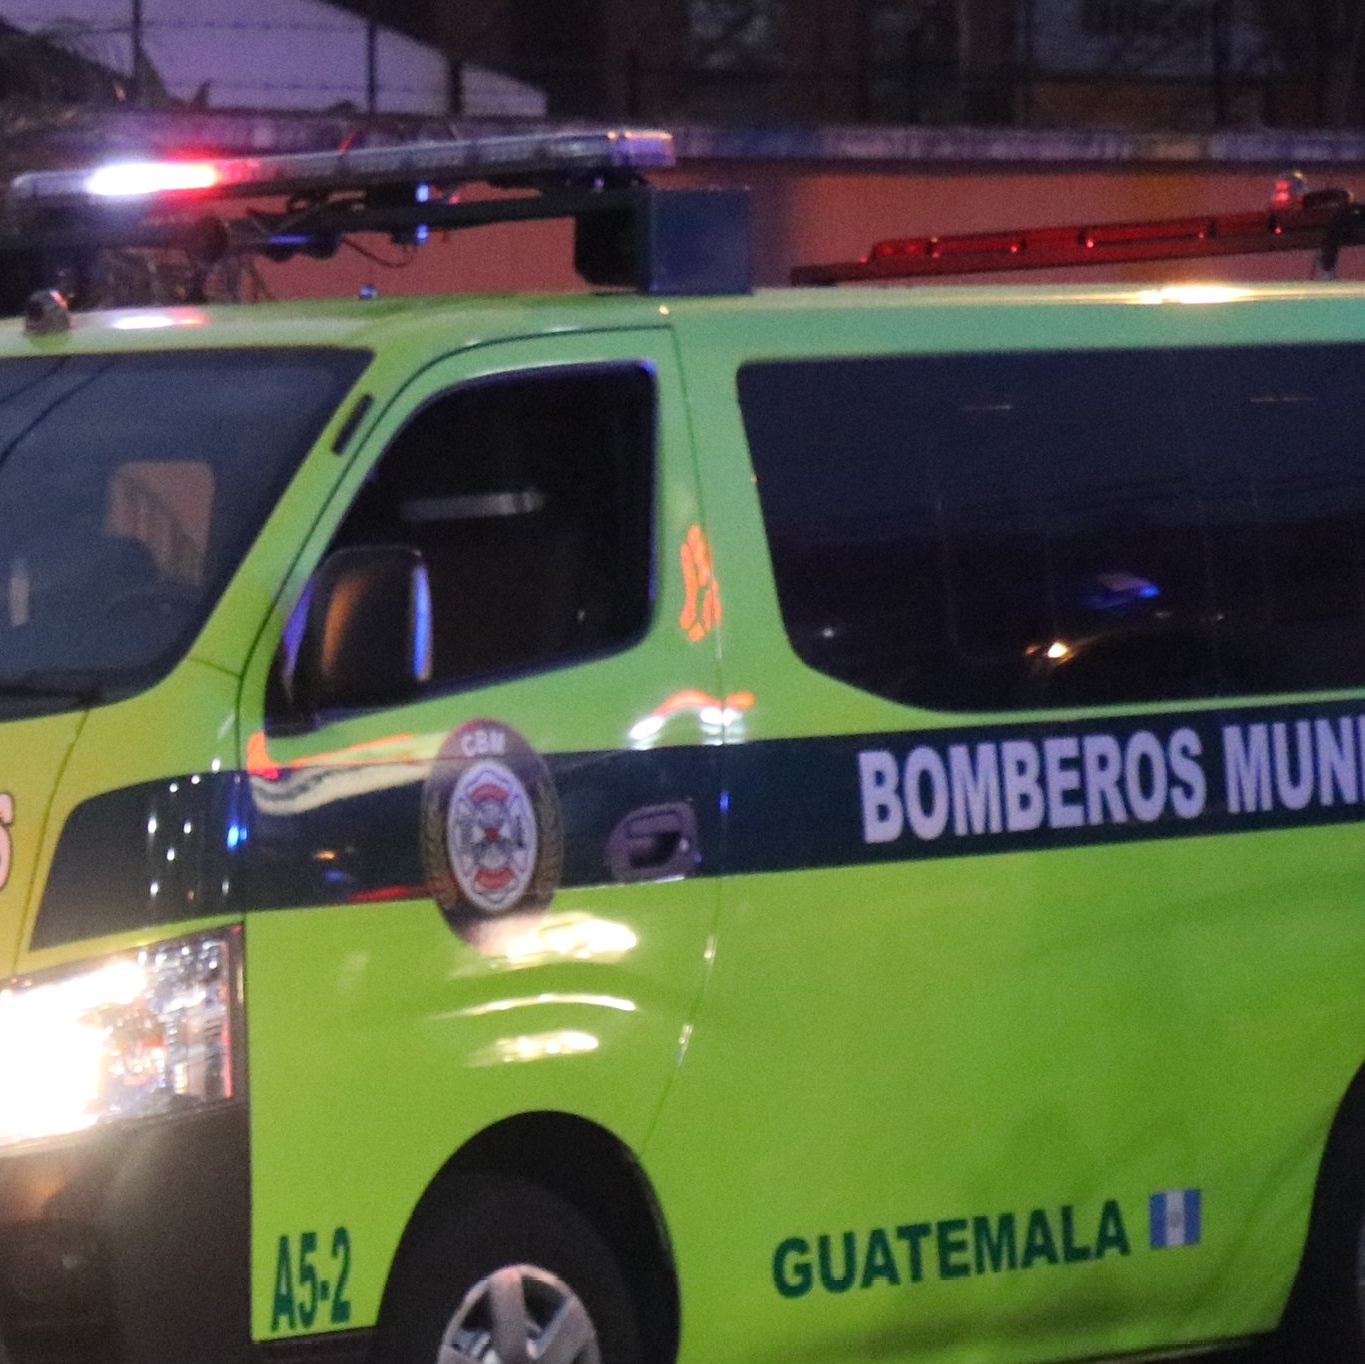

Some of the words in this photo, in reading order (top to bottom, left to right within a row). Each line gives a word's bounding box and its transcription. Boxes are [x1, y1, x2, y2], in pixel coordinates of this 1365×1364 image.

[858, 727, 1207, 844] BOMBEROS
[271, 1226, 351, 1332] A5-2
[772, 1199, 1131, 1300] GUATEMALA
